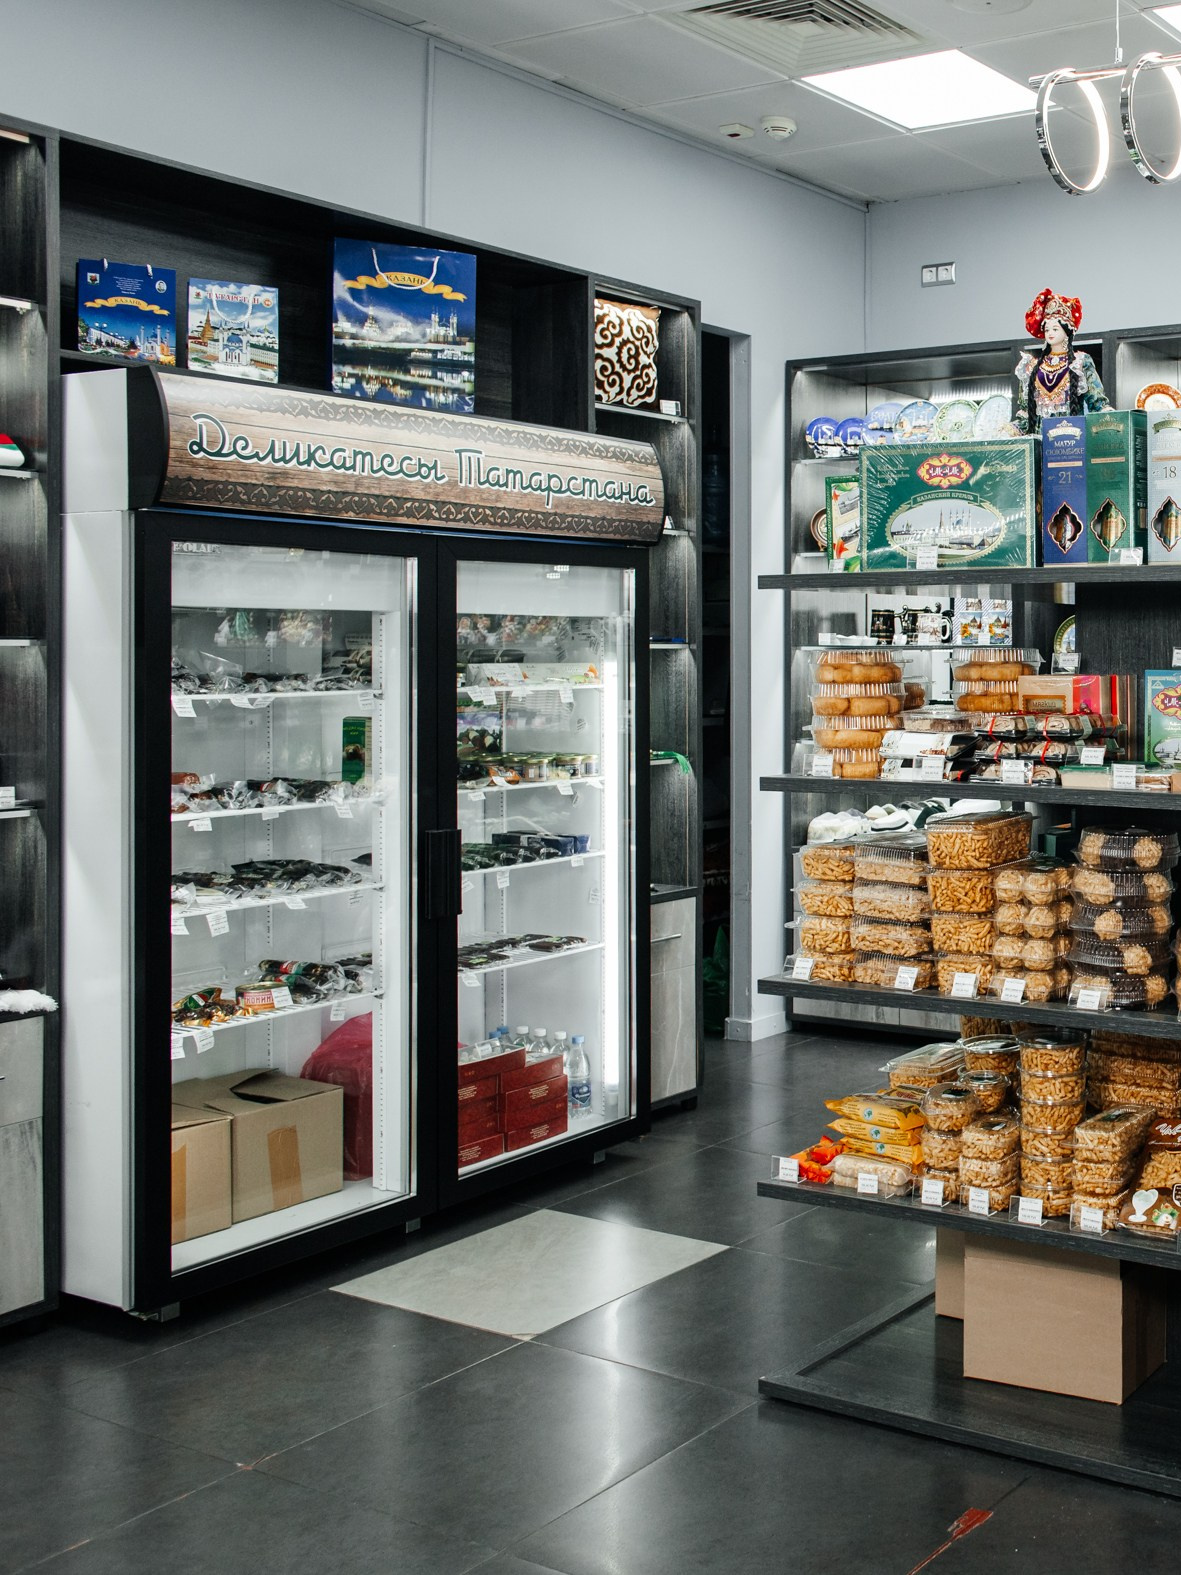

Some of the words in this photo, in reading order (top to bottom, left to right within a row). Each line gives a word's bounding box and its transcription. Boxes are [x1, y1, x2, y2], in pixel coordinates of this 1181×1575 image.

[386, 274, 426, 286] КАЗАНЬ
[114, 298, 142, 306] КАЗАНЬ
[188, 413, 448, 484] Деликатесы
[454, 448, 656, 508] Татарстана
[1058, 471, 1072, 484] 21
[1162, 466, 1177, 479] 18
[246, 995, 274, 1004] КОНИН
